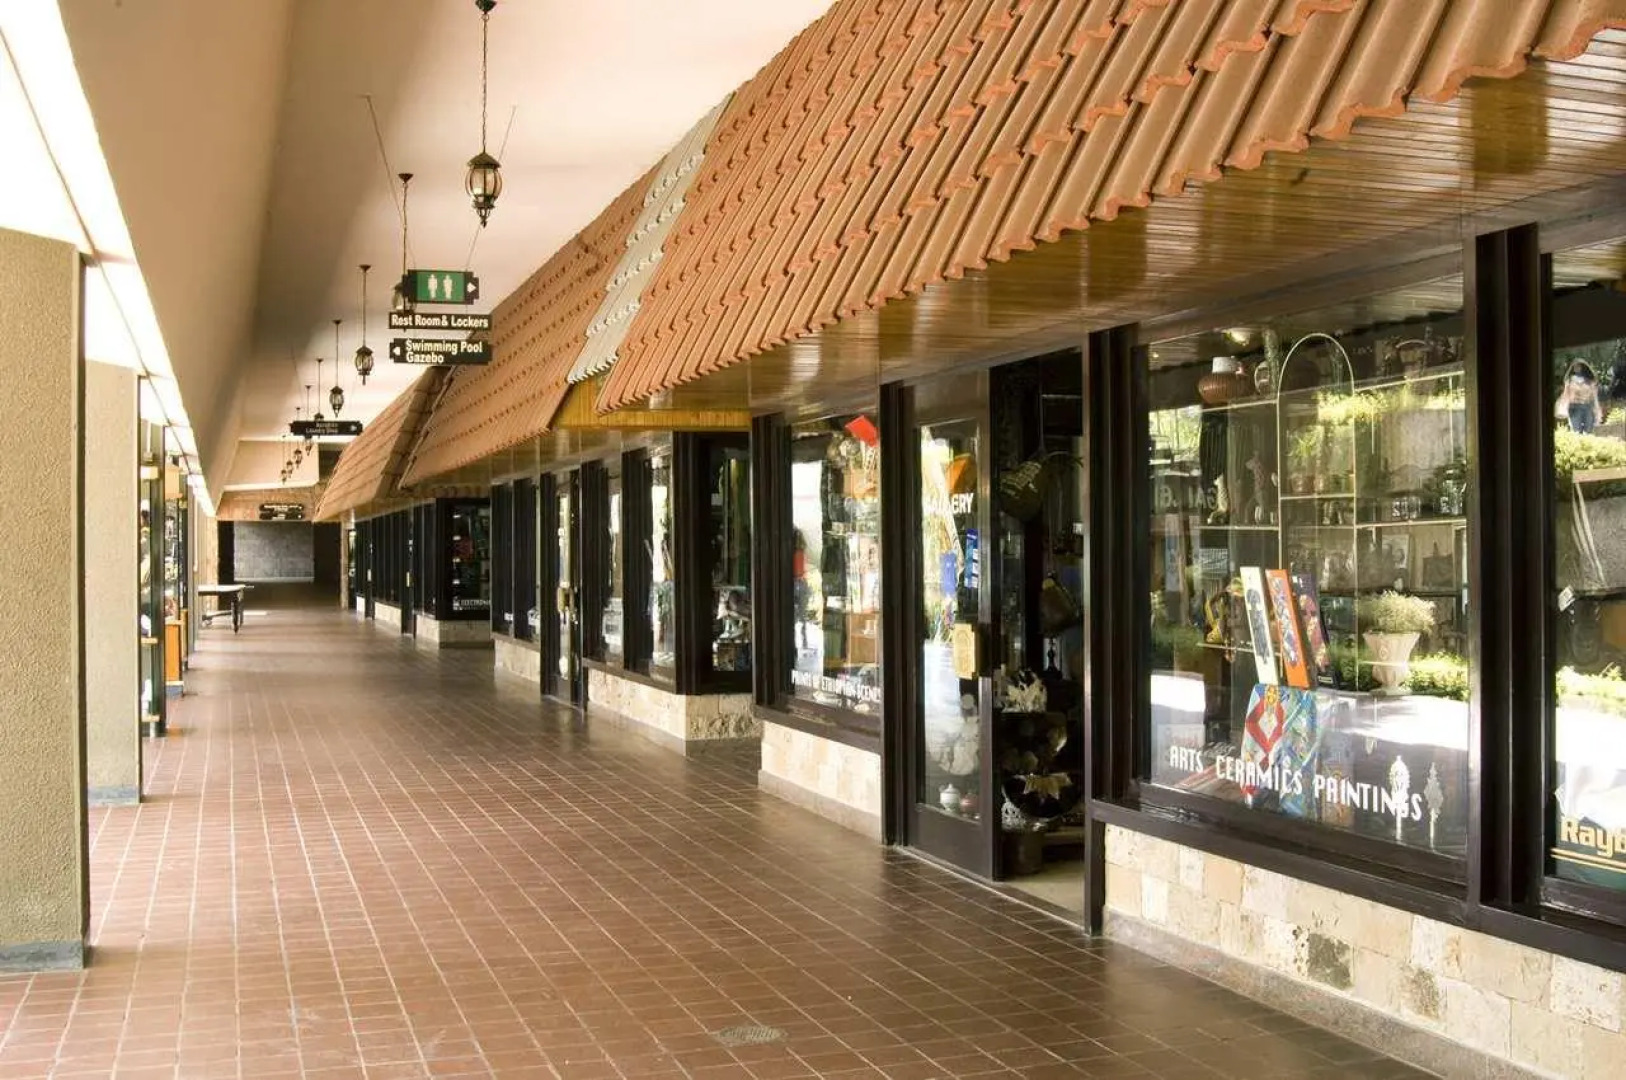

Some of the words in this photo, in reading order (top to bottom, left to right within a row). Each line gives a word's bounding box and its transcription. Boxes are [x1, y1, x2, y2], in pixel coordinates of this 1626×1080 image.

[391, 314, 413, 326] Rest
[414, 315, 440, 326] Room
[441, 315, 449, 326] &
[450, 315, 489, 328] Lockers
[405, 340, 458, 355] Swimming
[460, 341, 483, 353] Pool
[405, 351, 444, 364] Gazebo
[1169, 745, 1204, 773] ARTS
[1215, 754, 1303, 795] CERAMICS
[1314, 773, 1423, 822] PAINTINGS
